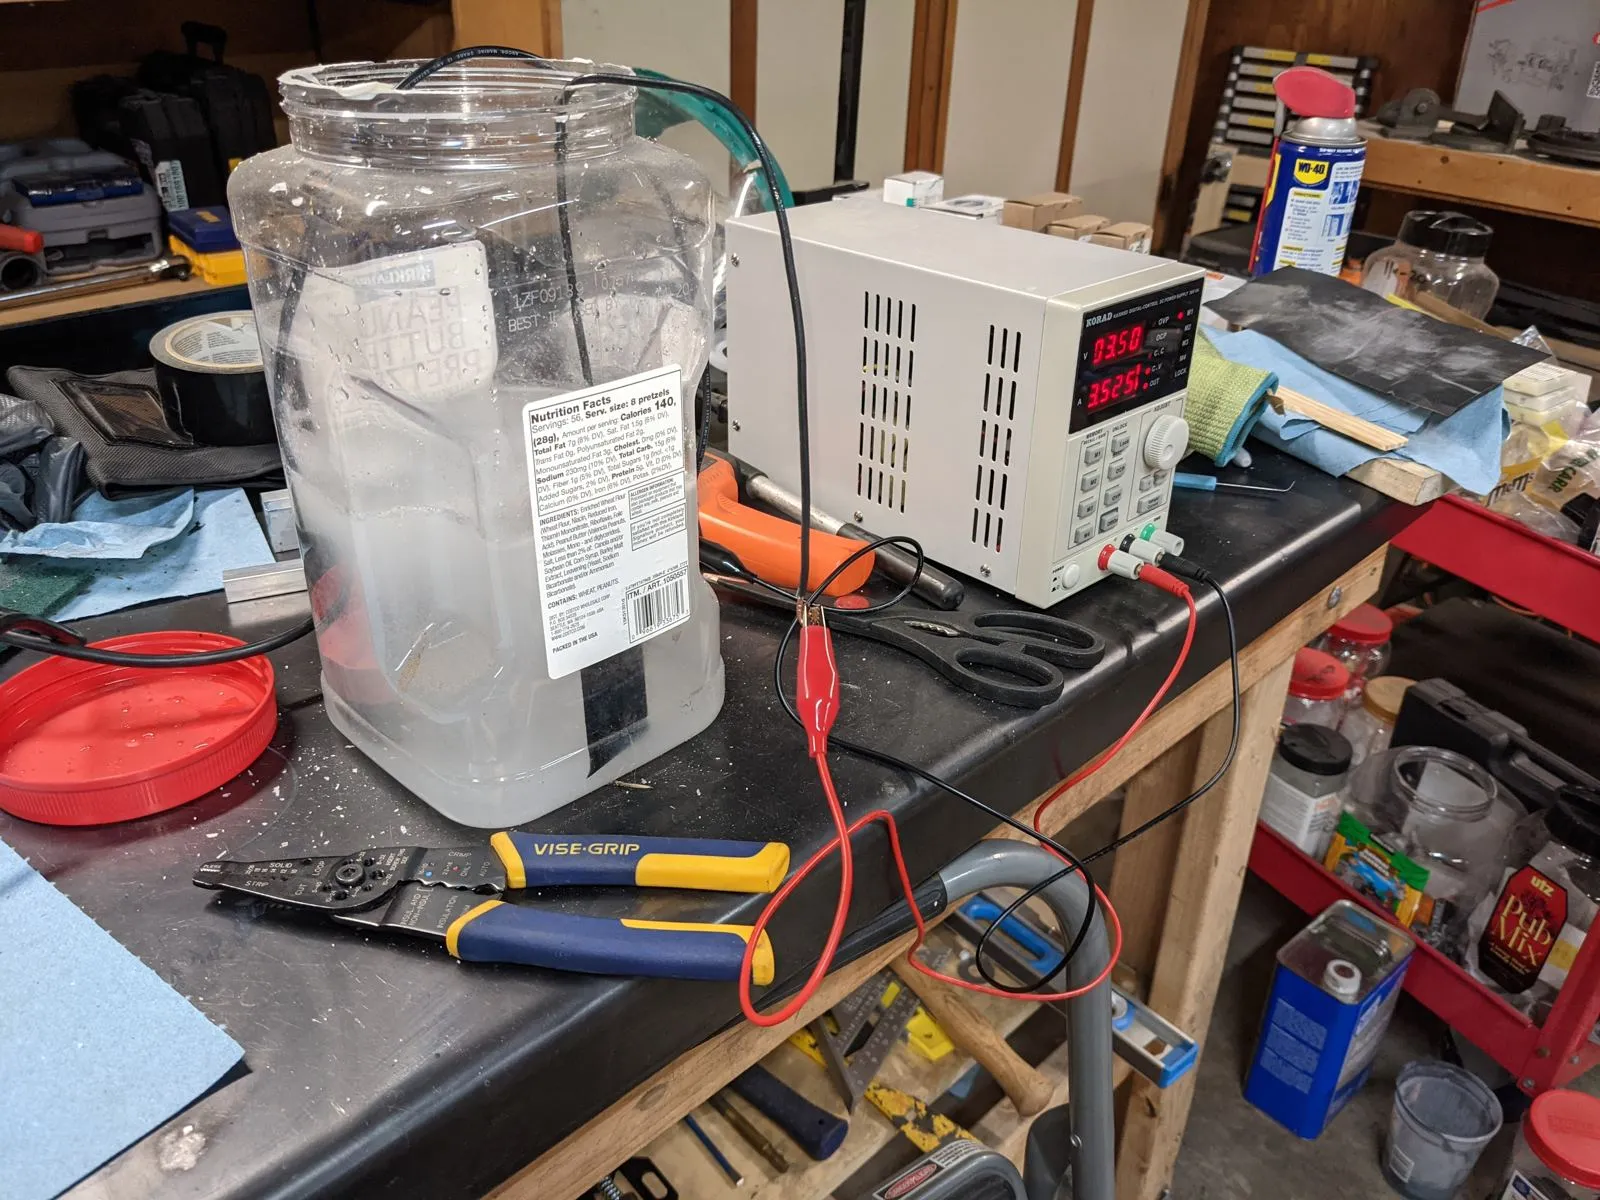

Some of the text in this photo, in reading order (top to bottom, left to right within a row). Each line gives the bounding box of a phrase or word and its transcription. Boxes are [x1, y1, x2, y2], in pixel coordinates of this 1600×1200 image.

[1298, 162, 1325, 174] WD-40
[508, 314, 540, 332] BEST
[1086, 312, 1113, 327] KORAD
[1158, 316, 1170, 326] OVP
[1149, 377, 1160, 387] OUT
[531, 396, 610, 423] Nutrition Facts
[531, 418, 568, 433] Servings:
[585, 408, 606, 418] Serv.
[609, 401, 628, 412] size:
[638, 389, 669, 404] pretzels
[562, 426, 585, 438] Amount
[586, 424, 596, 432] per
[620, 407, 651, 420] Calories
[533, 445, 551, 455] Total
[606, 427, 618, 435] Sat.
[535, 456, 551, 465] Trans
[553, 452, 564, 460] Fat
[576, 434, 624, 452] Polyunsaturated
[535, 454, 590, 476] Monounsaturated
[591, 450, 602, 458] Fat
[613, 439, 639, 451] Cholest.
[536, 472, 563, 485] Sodium
[618, 449, 634, 458] Total
[636, 444, 652, 453] Carb.
[607, 462, 620, 471] Total
[621, 456, 641, 467] Sugars
[537, 490, 559, 503] Added
[611, 467, 634, 479] Protein
[538, 499, 564, 512] Calcium
[539, 509, 577, 525] INGREDIENTS:
[627, 589, 641, 599] ITM.
[647, 580, 661, 590] ART.
[547, 594, 576, 608] CONTAINS:
[1531, 876, 1555, 897] utz
